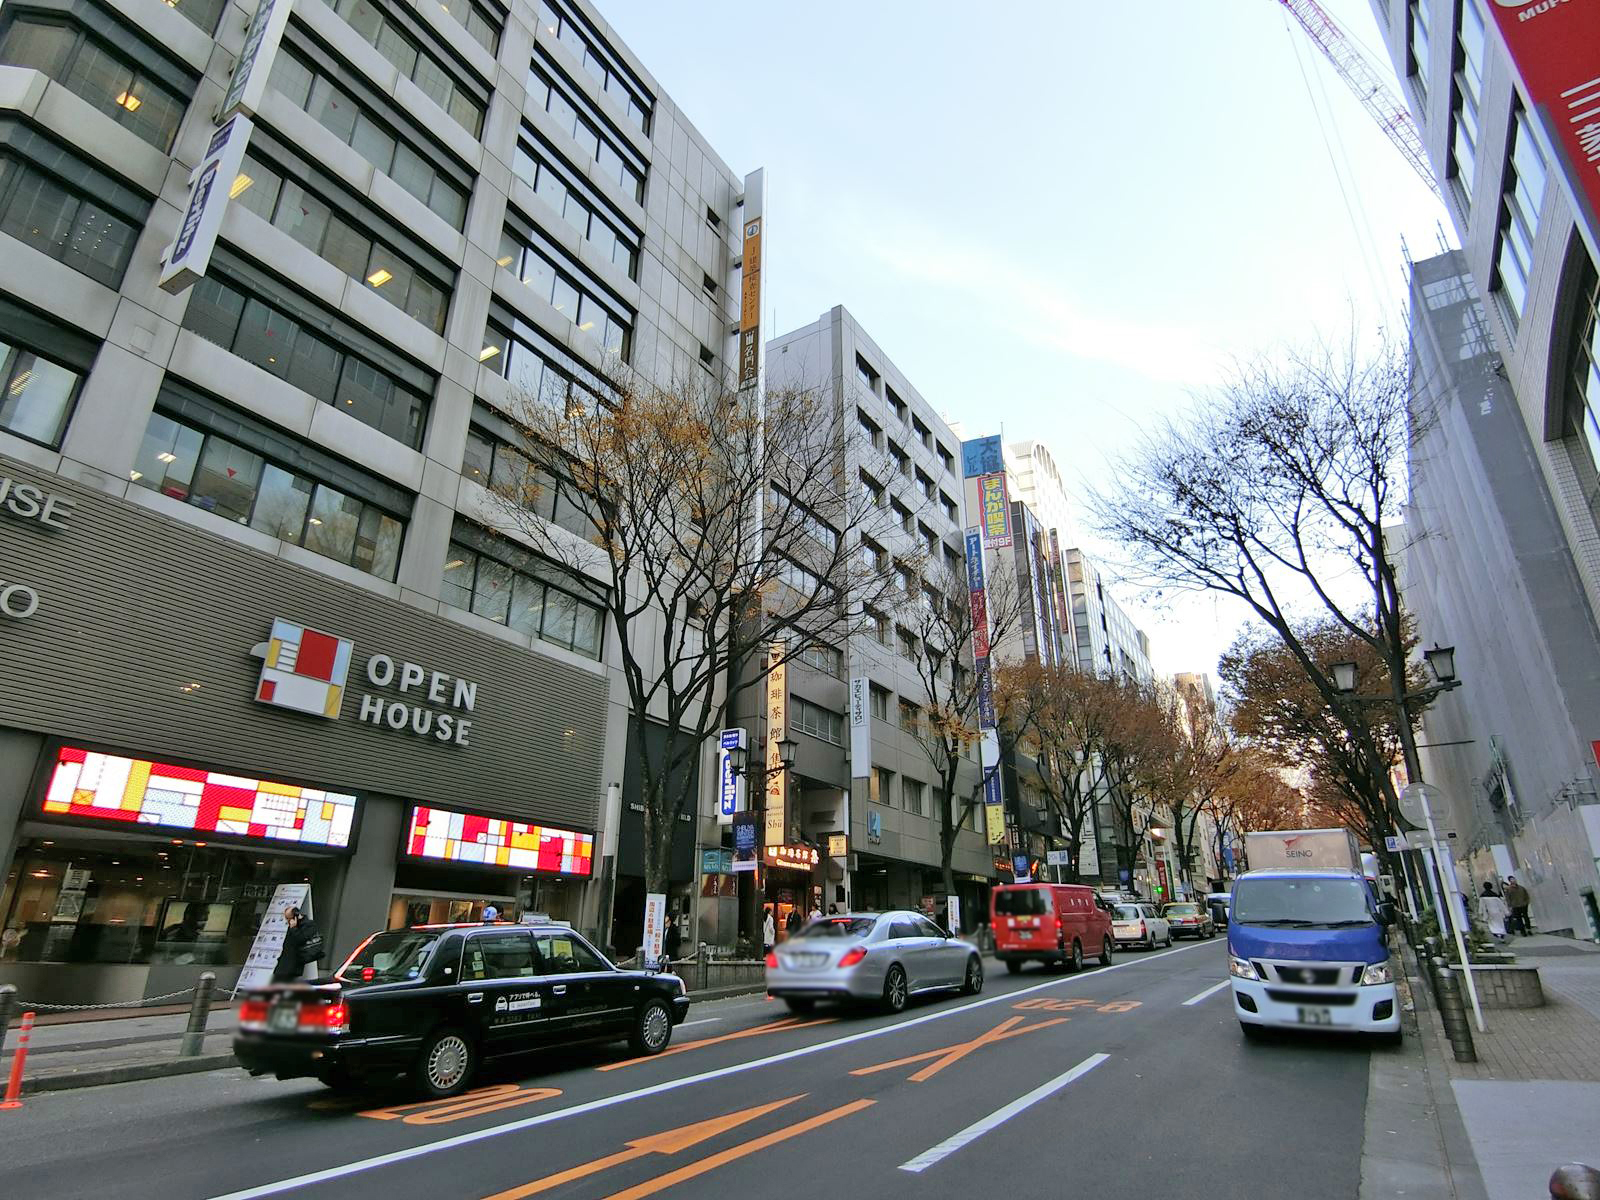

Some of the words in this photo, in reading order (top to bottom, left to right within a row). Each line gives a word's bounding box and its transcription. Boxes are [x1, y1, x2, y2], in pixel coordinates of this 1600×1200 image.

[176, 169, 217, 256] Berlitz
[983, 479, 1006, 537] まんが喫茶
[367, 654, 478, 711] OPEN
[360, 694, 472, 745] HOUSE
[1286, 849, 1313, 858] SEINO
